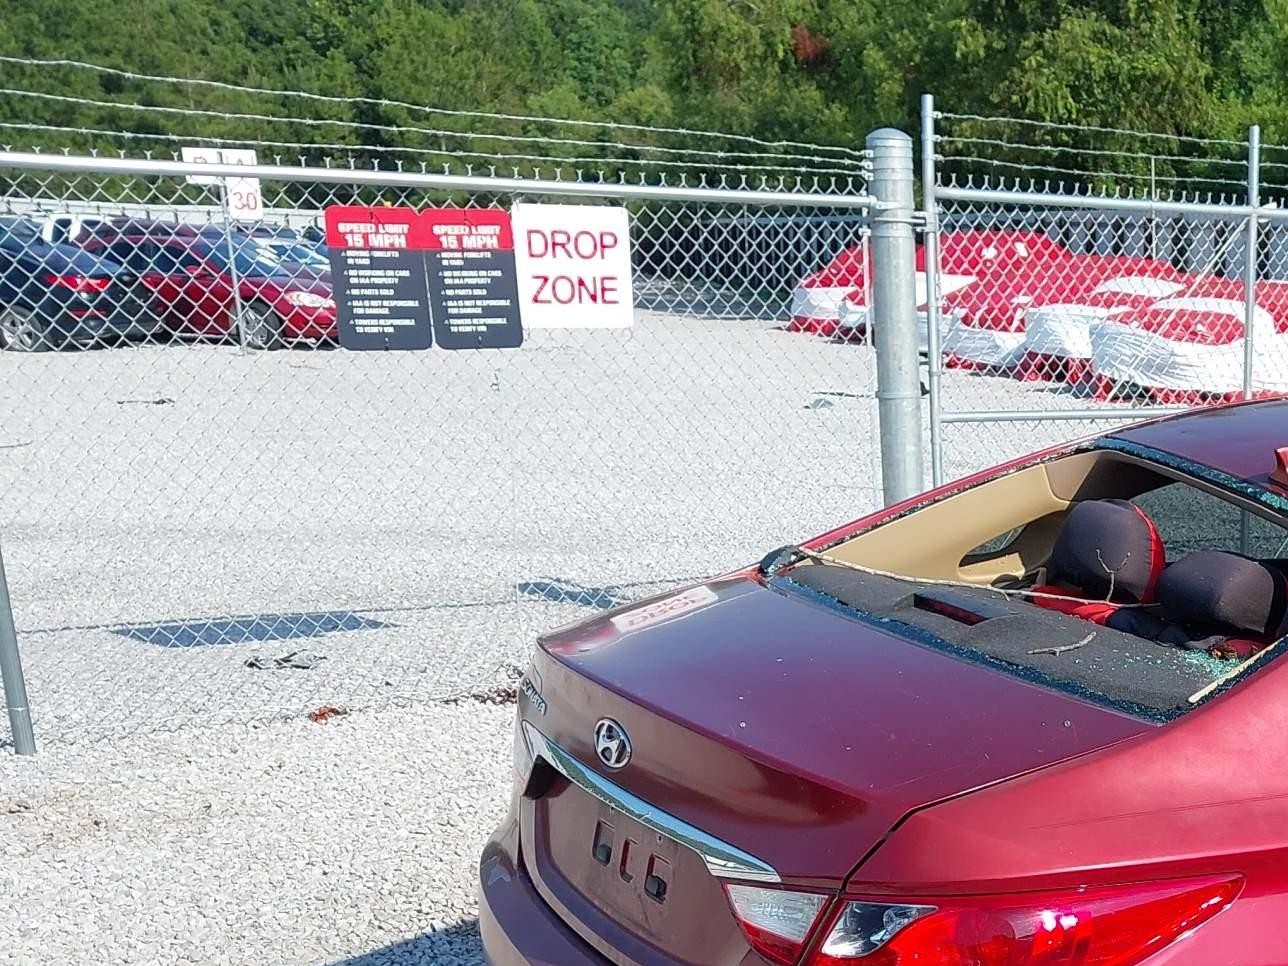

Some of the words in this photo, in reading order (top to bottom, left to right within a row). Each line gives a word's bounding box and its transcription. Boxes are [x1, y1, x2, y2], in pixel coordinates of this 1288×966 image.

[233, 192, 257, 210] 30
[337, 222, 376, 234] SPEED
[378, 223, 410, 235] LIMIT
[432, 225, 470, 236] SPEED
[471, 225, 501, 236] LIMIT
[344, 233, 365, 248] 15
[368, 234, 407, 249] MPH
[439, 235, 459, 249] 15
[462, 236, 499, 249] MPH
[527, 229, 618, 260] DROP
[532, 275, 619, 304] ZONE
